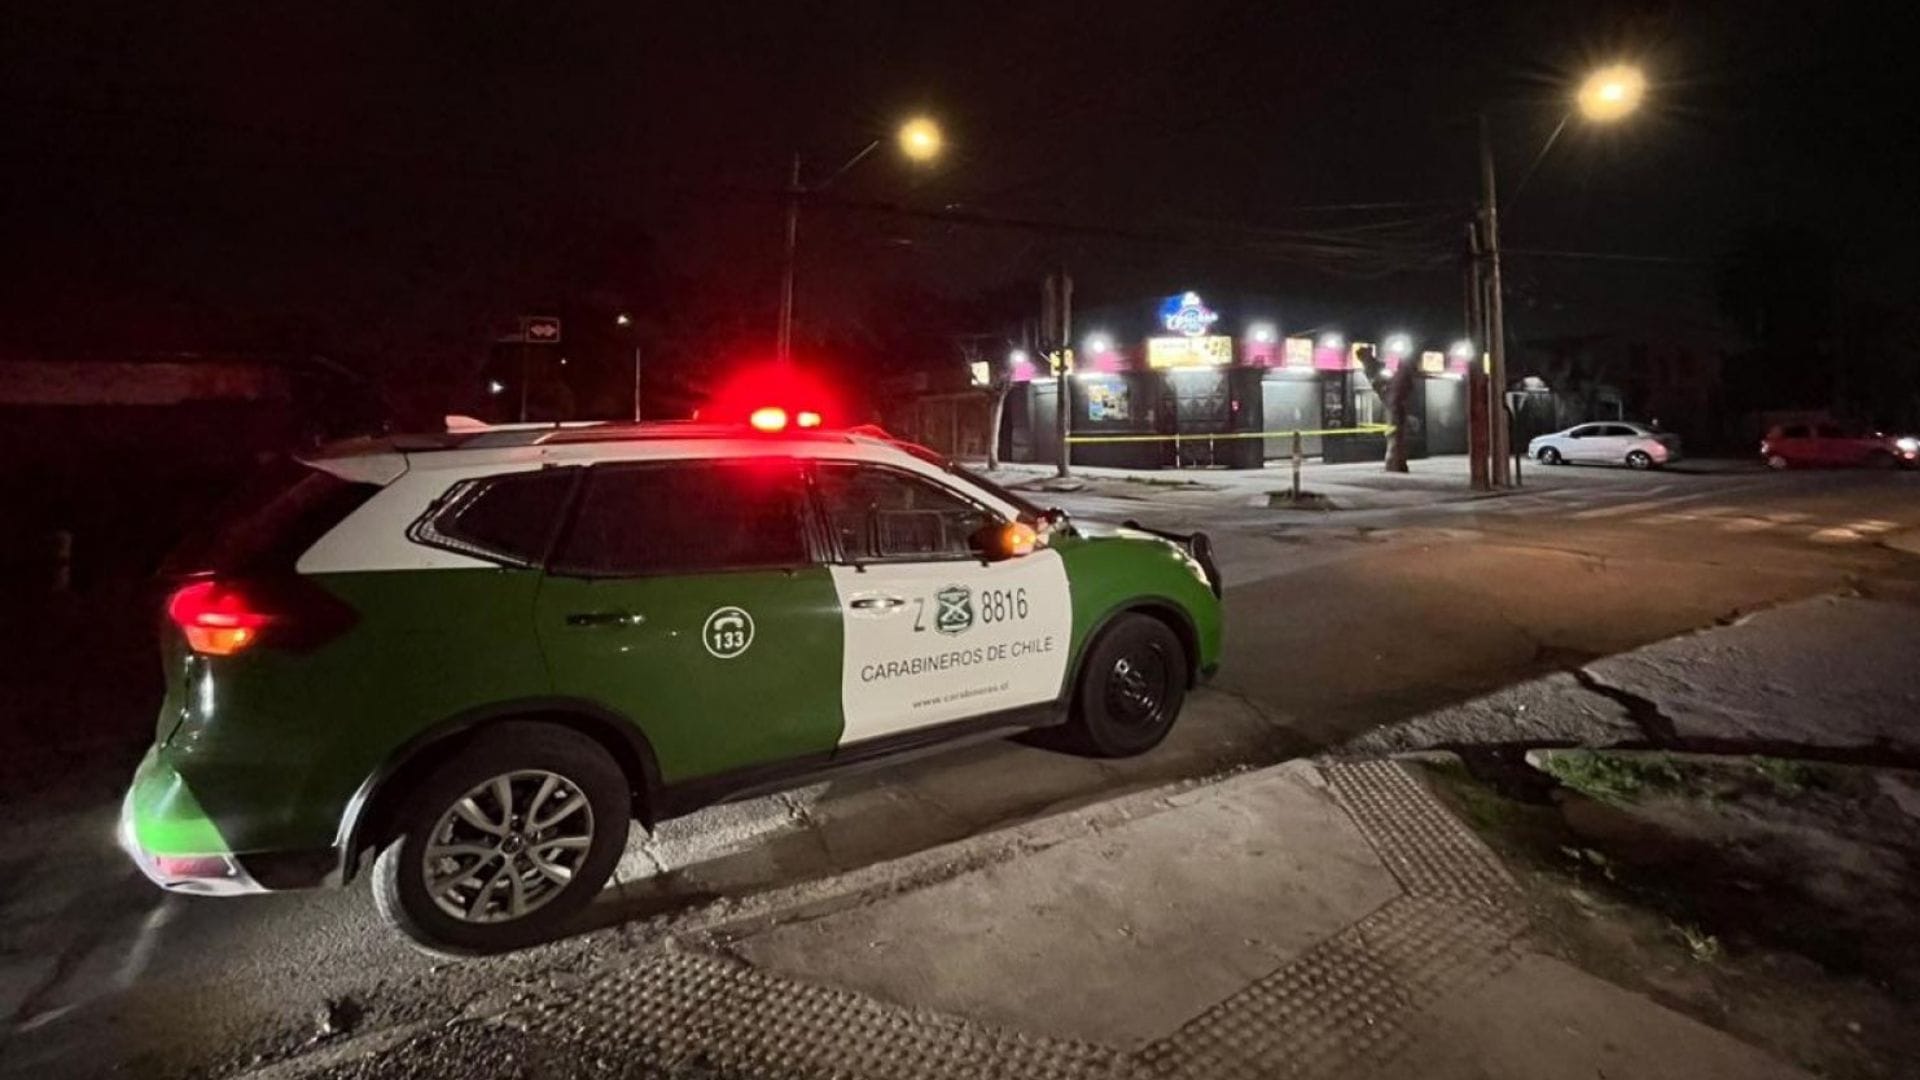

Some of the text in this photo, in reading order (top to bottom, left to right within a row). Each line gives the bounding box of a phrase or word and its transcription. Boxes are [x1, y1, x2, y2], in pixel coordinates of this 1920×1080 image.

[913, 588, 1028, 632] Z 8816
[714, 631, 745, 650] 133
[861, 636, 1053, 682] CARABINEROS DE CHILE
